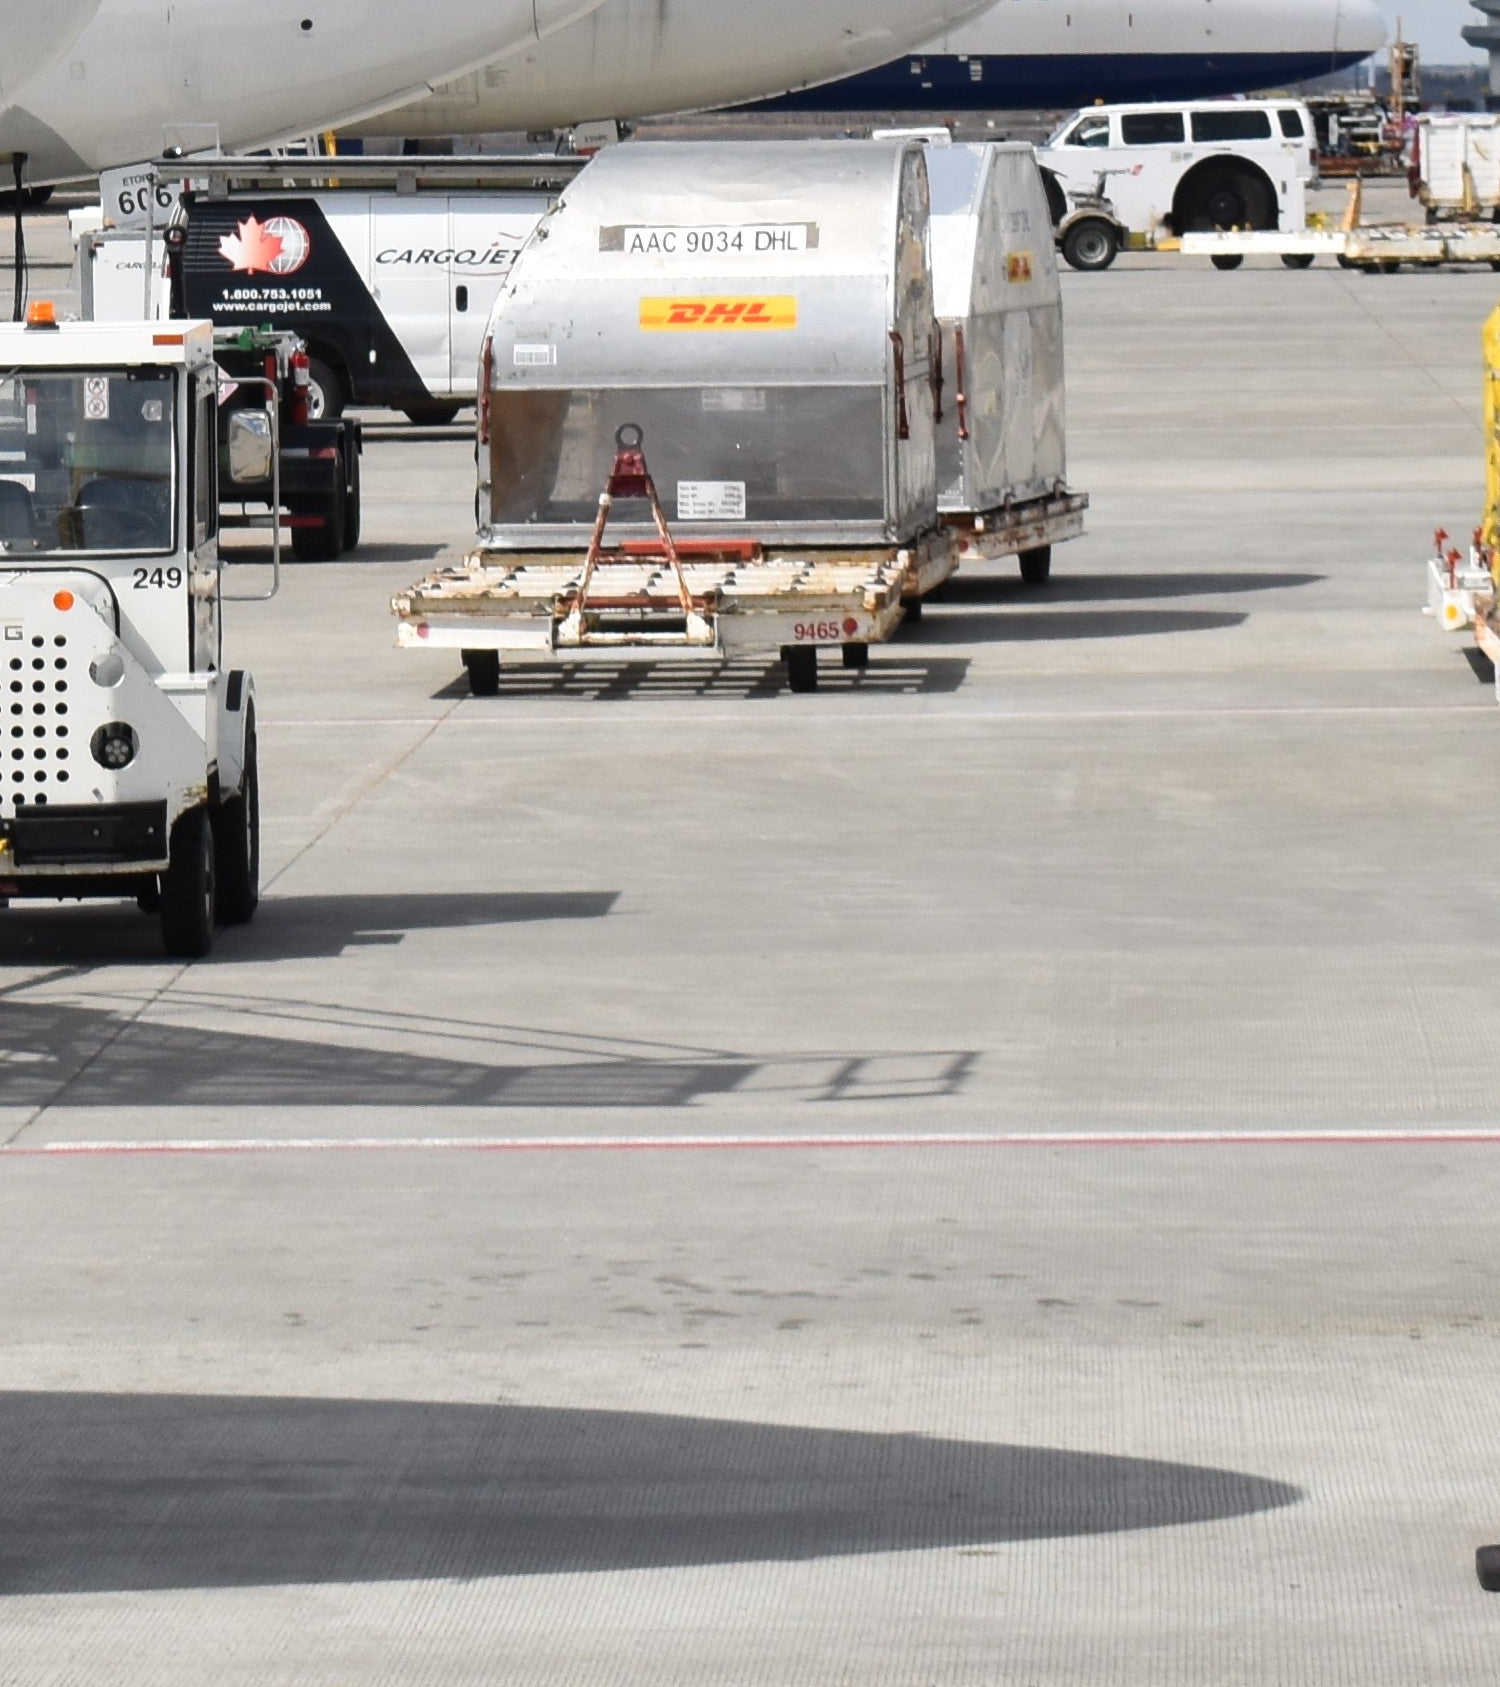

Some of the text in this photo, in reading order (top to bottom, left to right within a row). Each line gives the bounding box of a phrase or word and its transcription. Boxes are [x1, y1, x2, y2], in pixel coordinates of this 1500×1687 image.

[629, 230, 798, 253] AAC 9034 DHL
[222, 289, 323, 300] 1.800.753.1051
[212, 301, 332, 313] www.cargojet.com
[667, 303, 774, 324] DHL
[132, 567, 183, 590] 249
[794, 621, 840, 641] 9465
